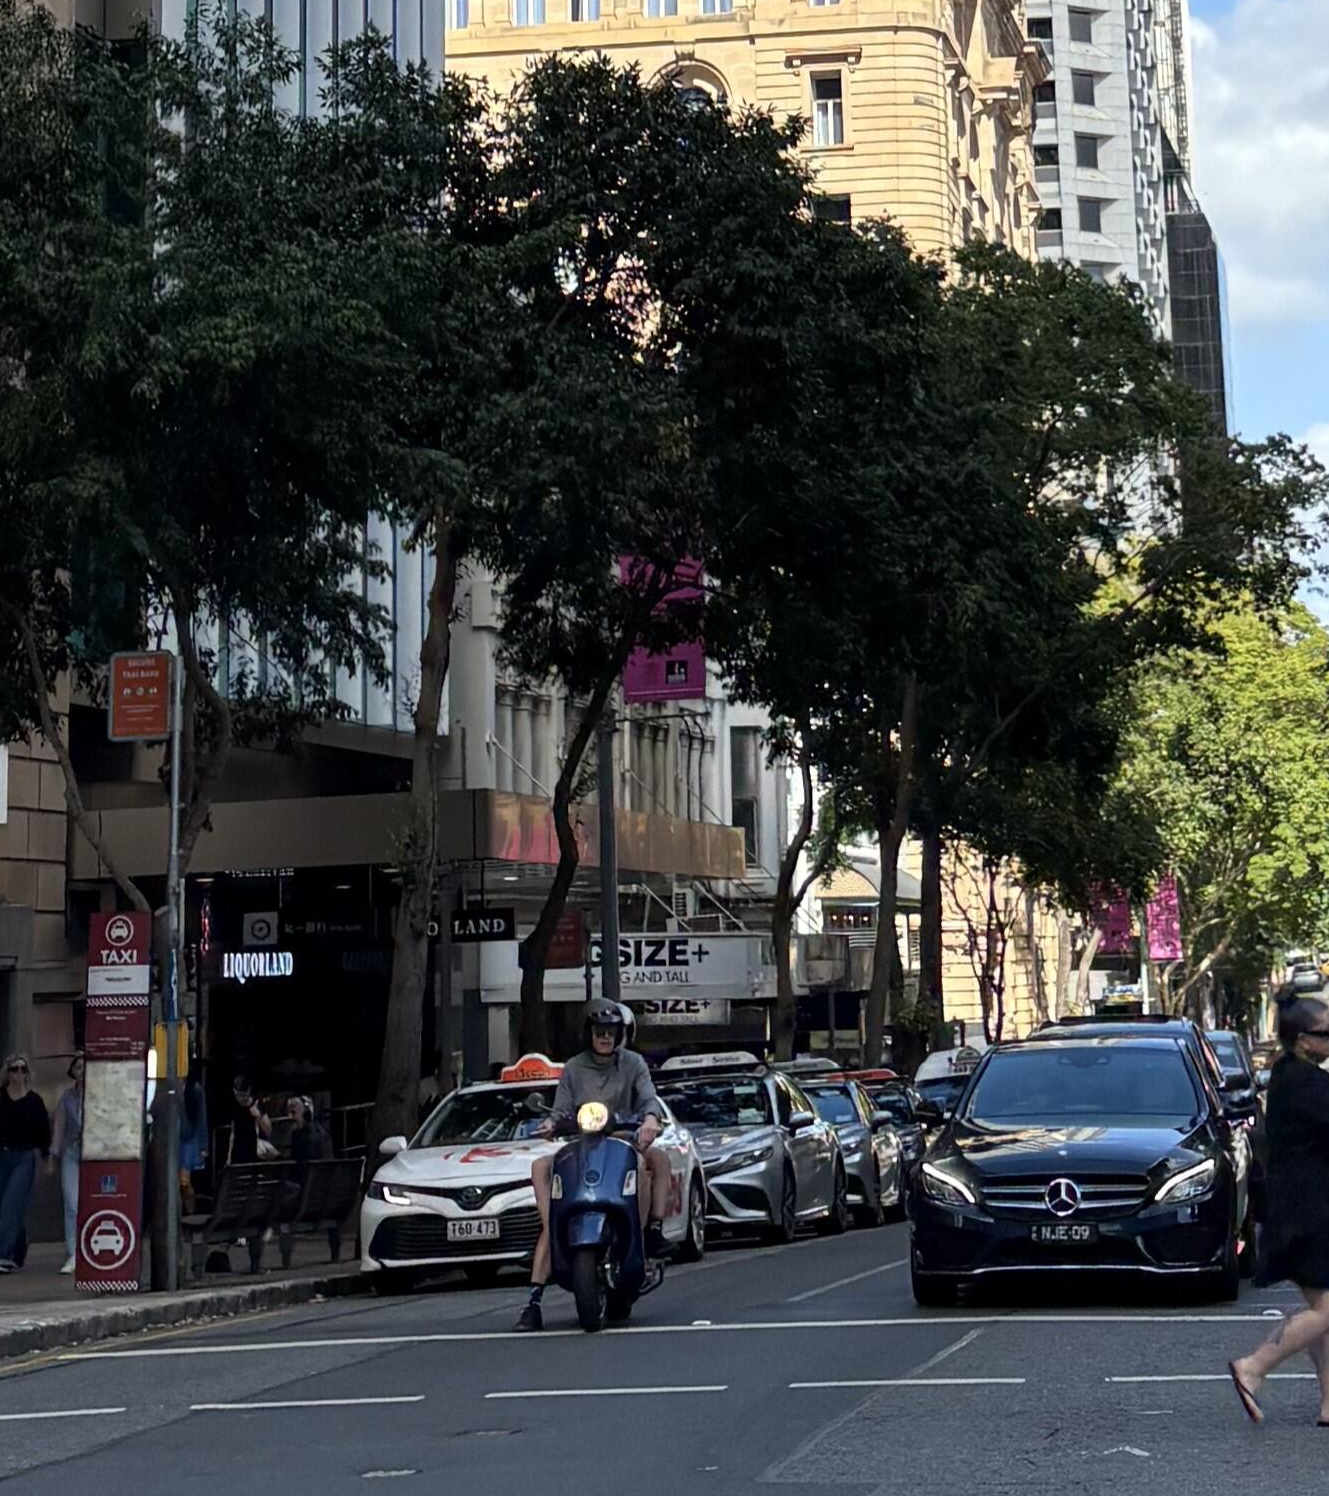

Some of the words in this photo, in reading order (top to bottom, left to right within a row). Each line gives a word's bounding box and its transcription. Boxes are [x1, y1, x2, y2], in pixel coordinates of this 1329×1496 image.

[100, 948, 137, 964] TAXI
[222, 951, 295, 984] LIQUORLAND
[634, 970, 663, 983] AND
[665, 970, 689, 983] TALL
